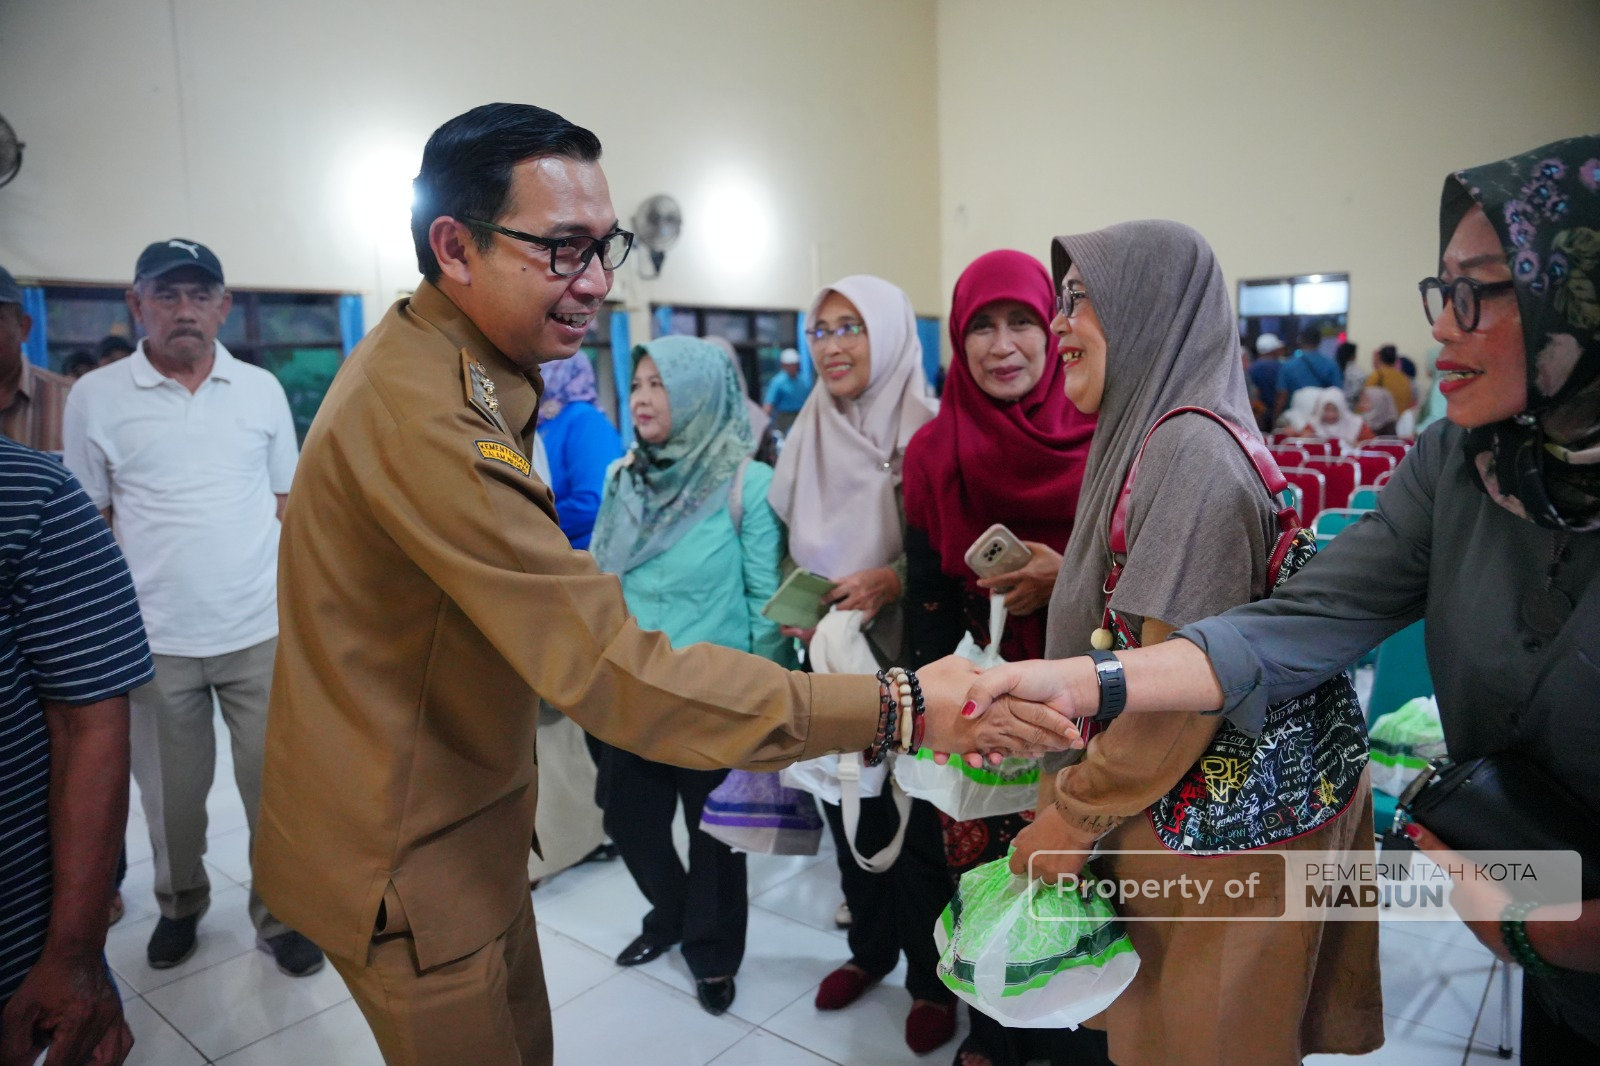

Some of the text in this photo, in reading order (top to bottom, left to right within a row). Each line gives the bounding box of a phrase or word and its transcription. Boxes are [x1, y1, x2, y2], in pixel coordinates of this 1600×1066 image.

[480, 443, 530, 469] KEMENTERIAN
[1270, 709, 1286, 723] CITY
[1229, 735, 1247, 747] CITY
[1239, 749, 1251, 758] THE
[1227, 828, 1246, 838] DKNY
